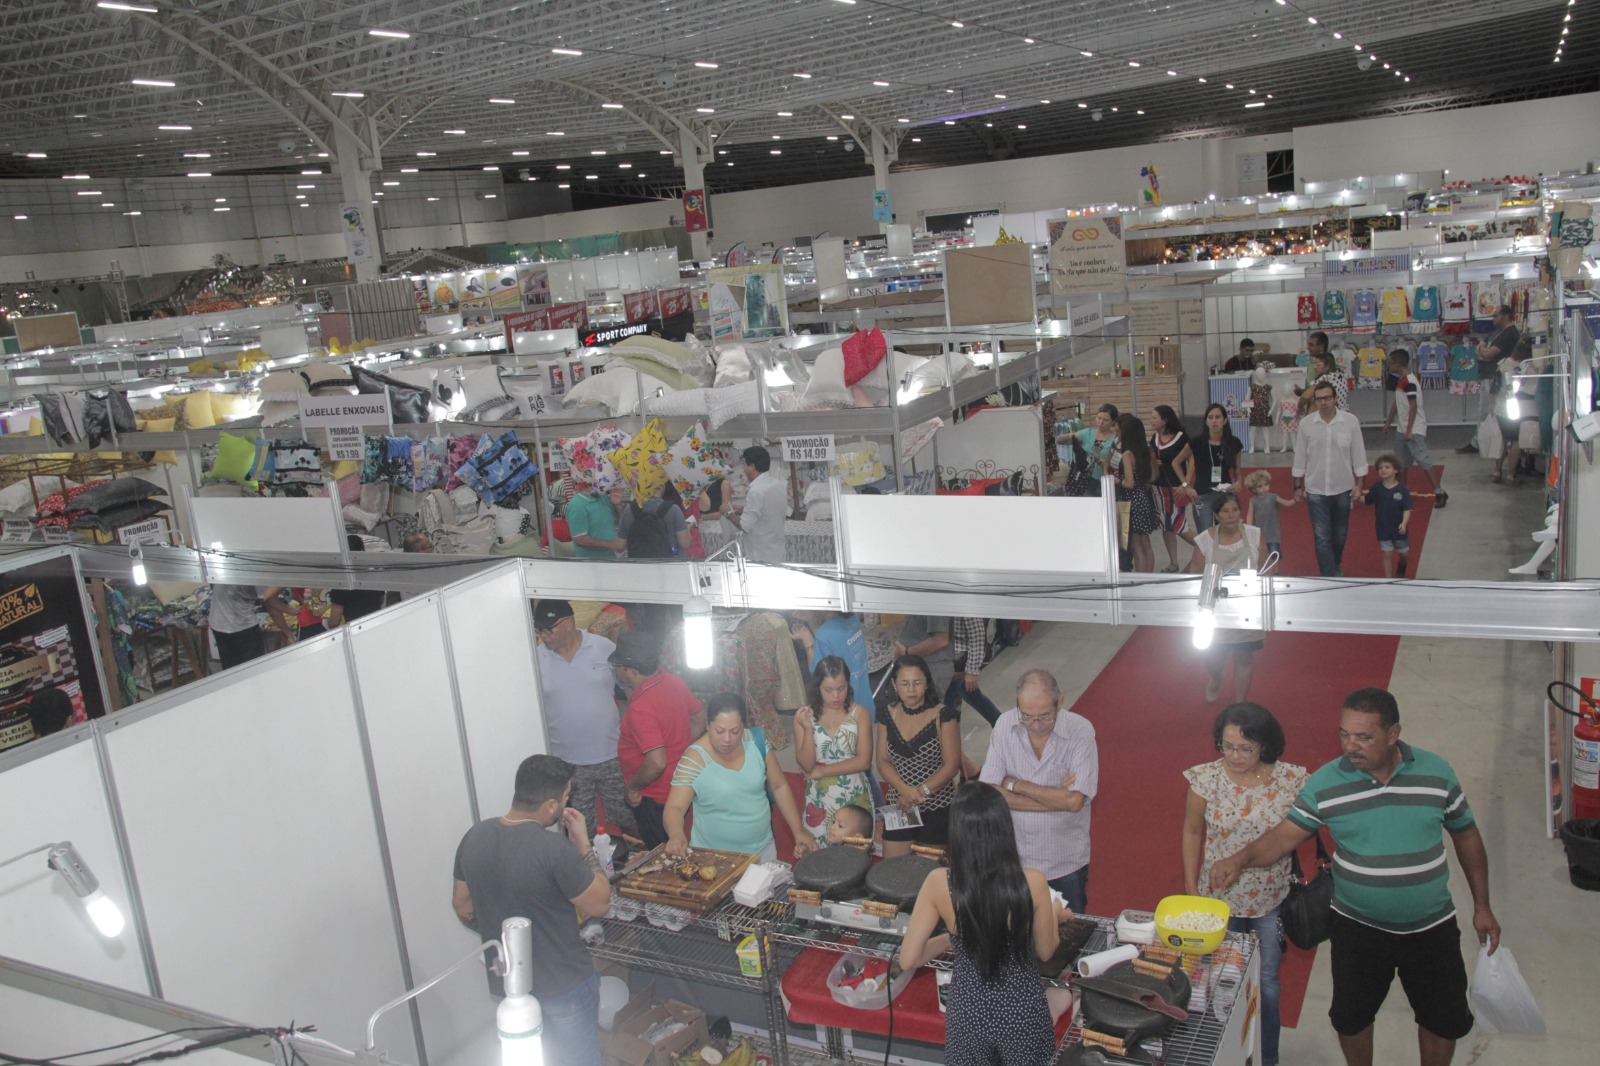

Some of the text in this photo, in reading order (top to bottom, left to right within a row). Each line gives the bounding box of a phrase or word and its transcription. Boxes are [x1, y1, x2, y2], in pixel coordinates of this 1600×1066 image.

[596, 329, 619, 343] SPORT
[619, 323, 648, 338] COMPANY
[305, 405, 385, 417] LABELLE ENXOVAIS
[329, 425, 360, 436] PROMOÇÃO
[790, 448, 827, 460] R$ 14,99
[123, 521, 159, 538] PROMOÇÃO
